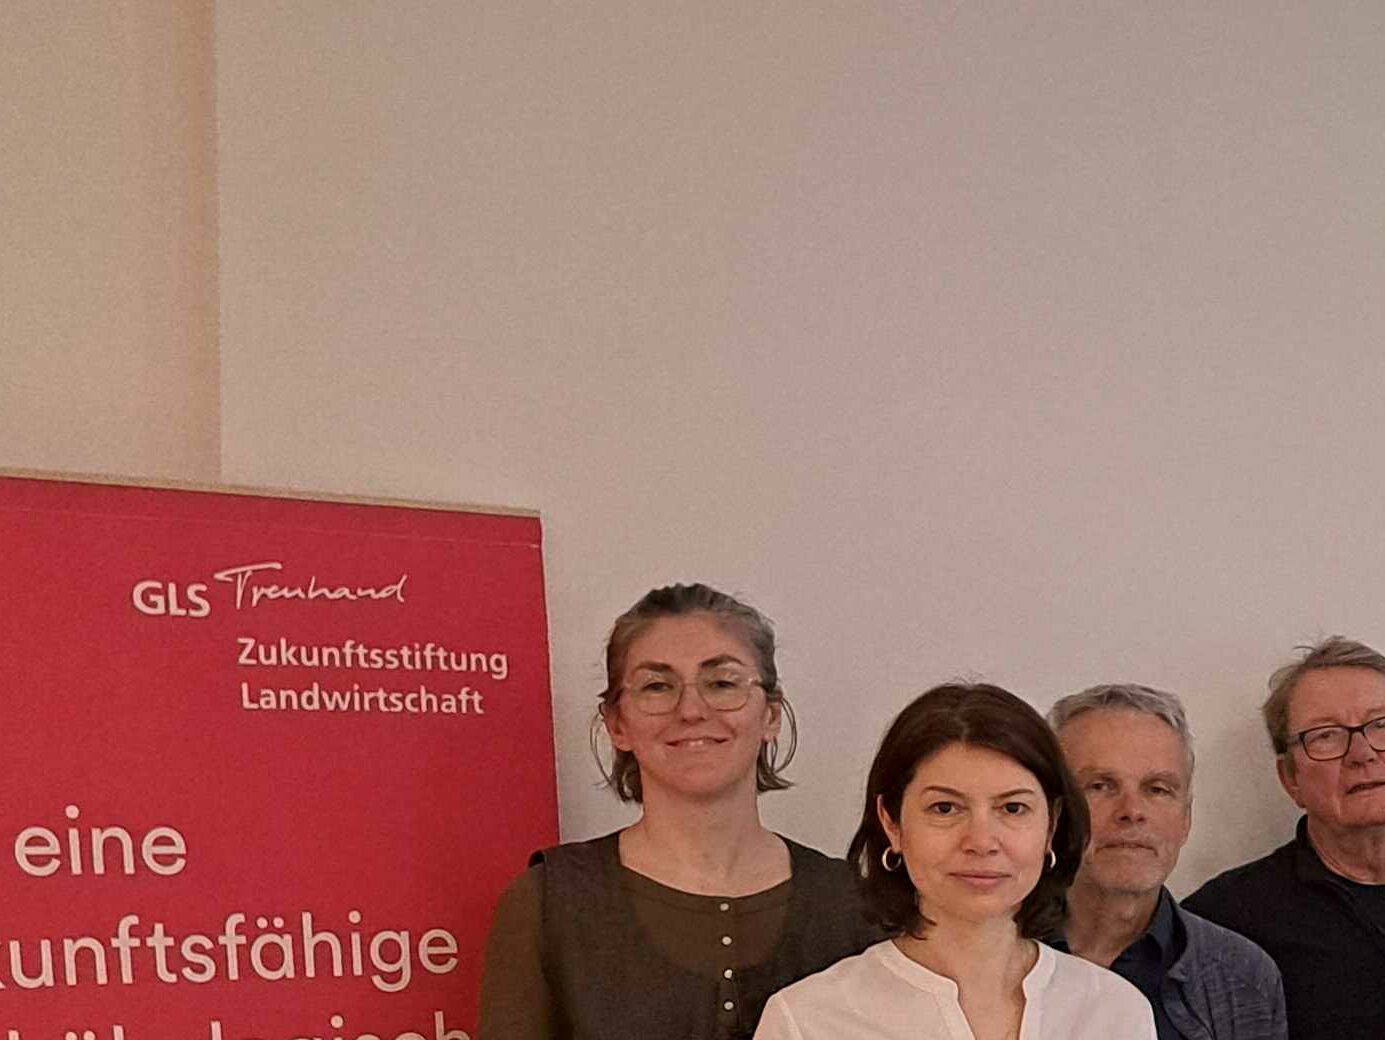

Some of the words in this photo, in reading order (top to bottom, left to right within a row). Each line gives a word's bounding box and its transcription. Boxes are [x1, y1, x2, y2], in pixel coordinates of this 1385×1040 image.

[132, 579, 210, 617] GLS
[213, 562, 407, 610] Treuhand
[237, 637, 509, 680] Zukunftsstiftung
[241, 682, 484, 714] Landwirtschaft
[14, 805, 187, 876] eine
[0, 910, 458, 993] unftsfähige
